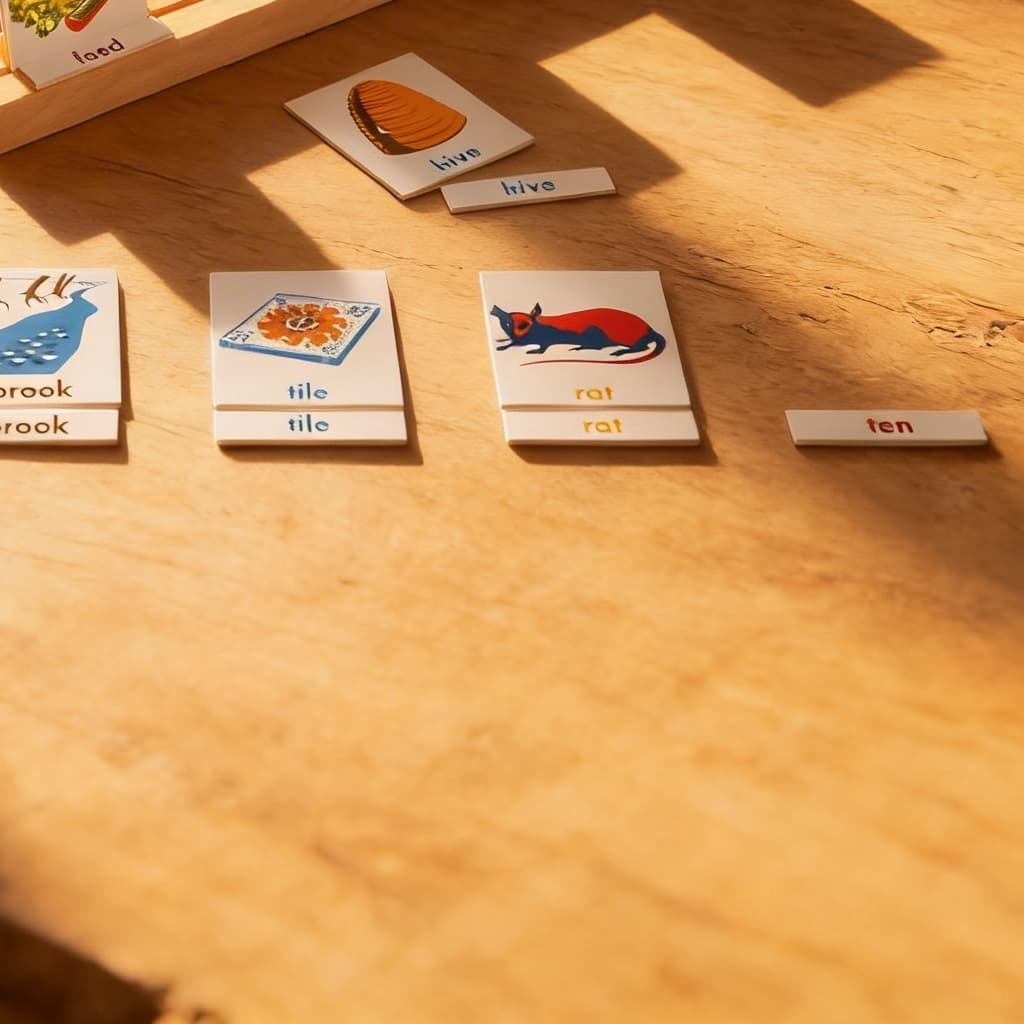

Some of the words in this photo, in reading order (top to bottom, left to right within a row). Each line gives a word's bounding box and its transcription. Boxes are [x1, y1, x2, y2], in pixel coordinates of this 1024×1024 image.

[288, 382, 328, 400] tile
[575, 385, 613, 401] rat
[288, 414, 329, 433] tile
[583, 418, 623, 435] rat
[868, 417, 914, 434] ten
